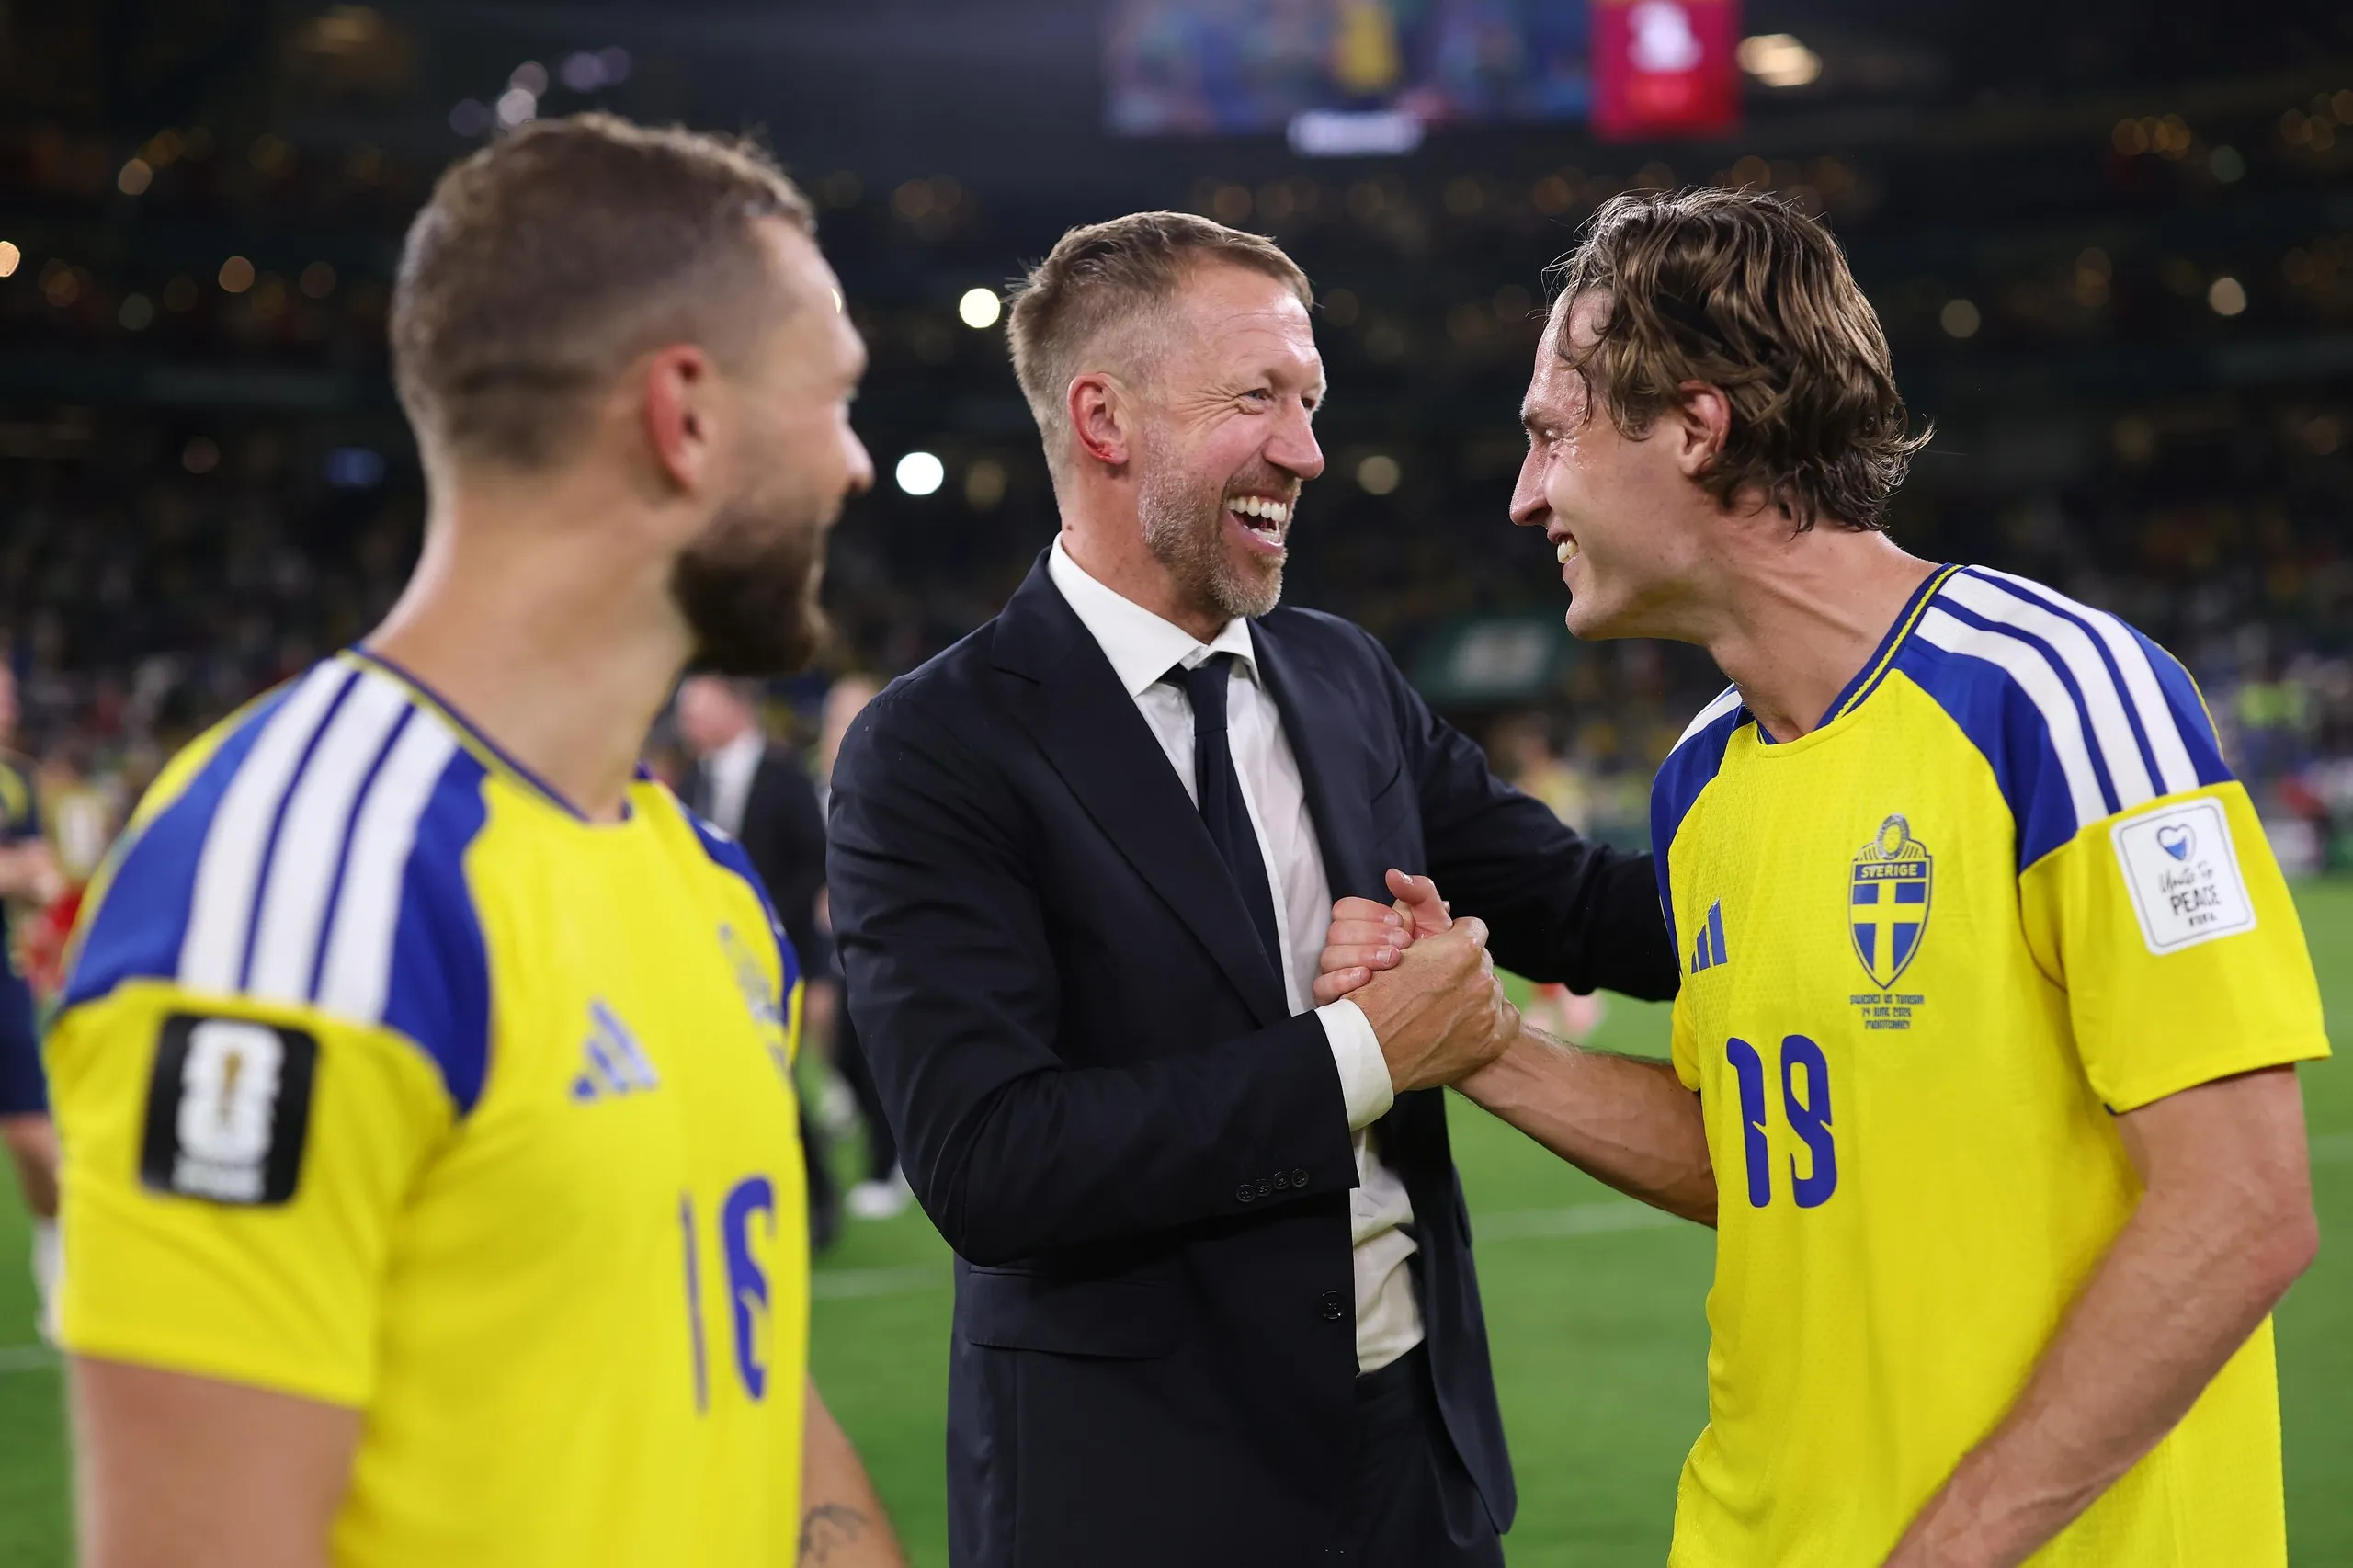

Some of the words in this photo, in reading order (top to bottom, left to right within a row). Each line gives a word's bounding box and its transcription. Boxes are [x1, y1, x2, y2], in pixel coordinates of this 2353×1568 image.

[1861, 864, 1918, 878] SVERIGE
[2170, 884, 2221, 916] PEACE
[1725, 1034, 1837, 1209] 19
[678, 1174, 775, 1417] 16
